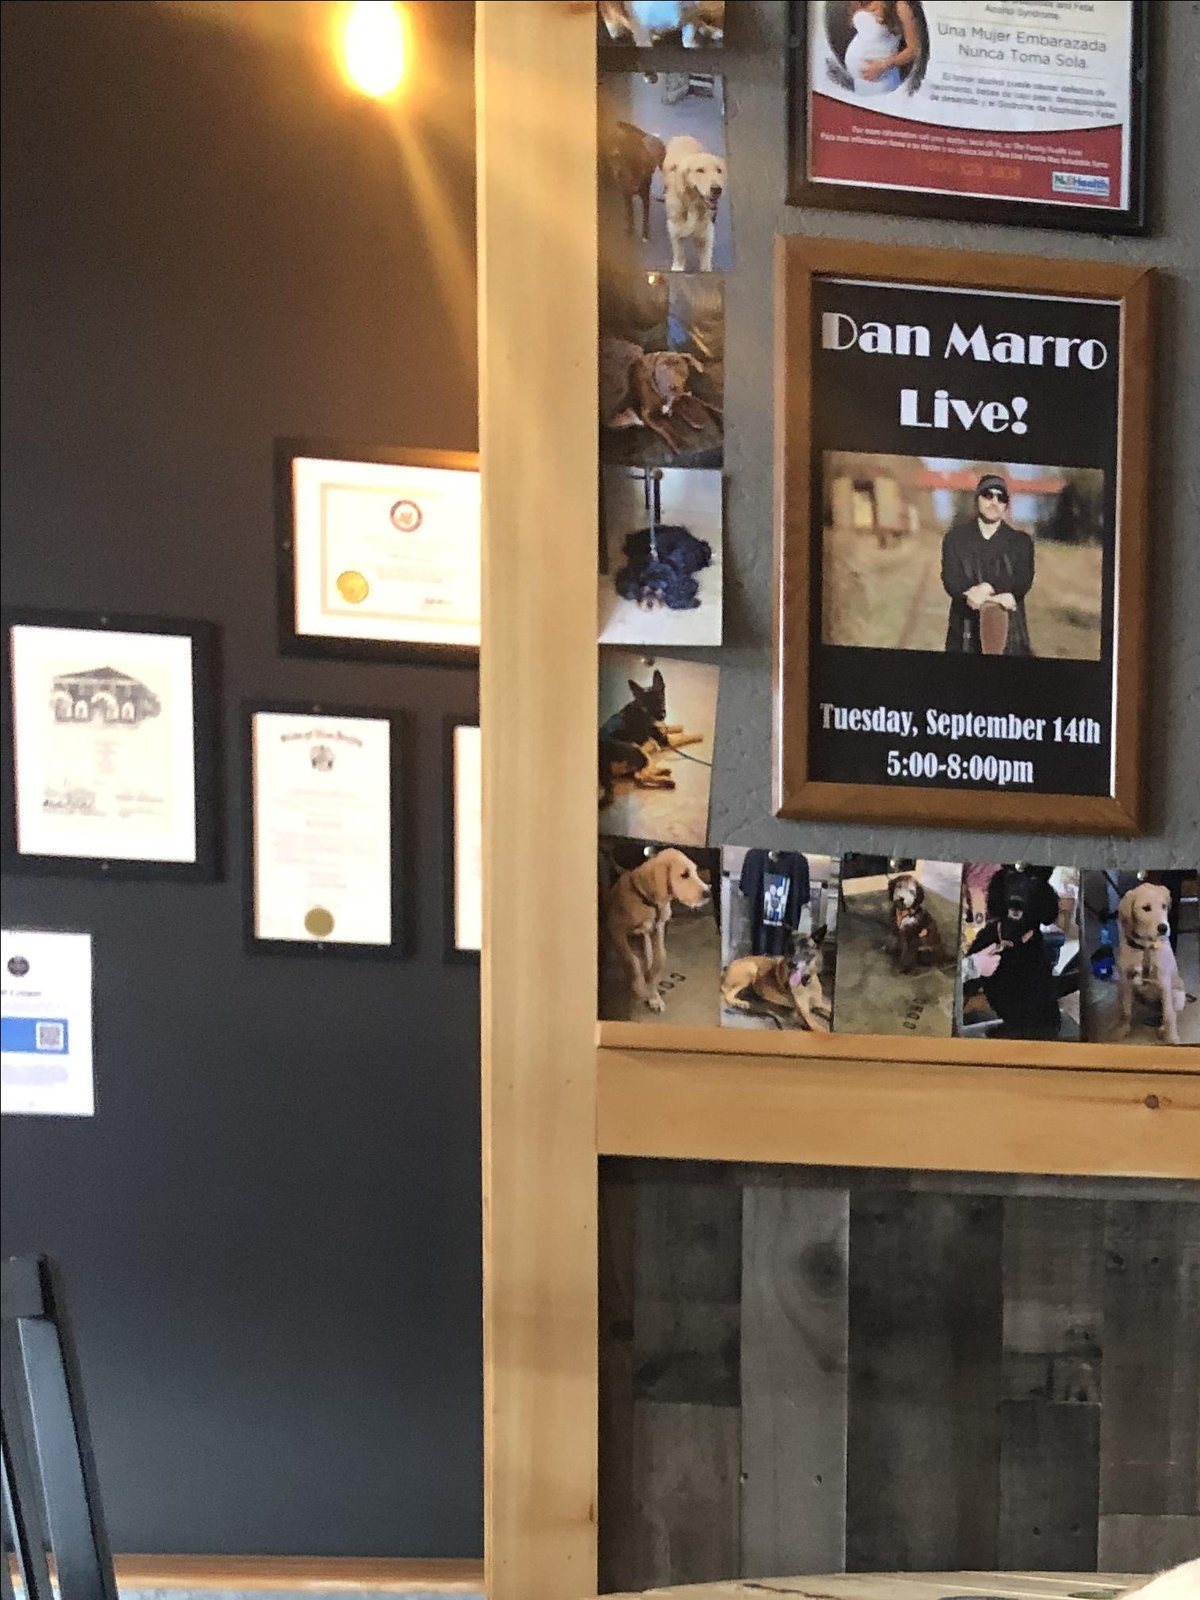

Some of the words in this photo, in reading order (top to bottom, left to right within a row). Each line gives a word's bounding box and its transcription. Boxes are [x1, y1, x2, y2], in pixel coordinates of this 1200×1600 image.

[937, 23, 966, 38] Una
[971, 26, 1010, 43] Mujer
[1016, 31, 1107, 53] Embarazada
[958, 44, 1004, 60] Nunca
[1010, 49, 1051, 65] Toma
[1056, 54, 1089, 69] Sola.
[822, 312, 930, 357] Dan
[944, 321, 1107, 371] Marro
[900, 388, 1029, 435] Live!
[819, 702, 919, 737] Tuesday,
[926, 708, 1046, 741] September
[1052, 716, 1101, 745] 14th
[886, 750, 1034, 786] 5:00-8:00pm
